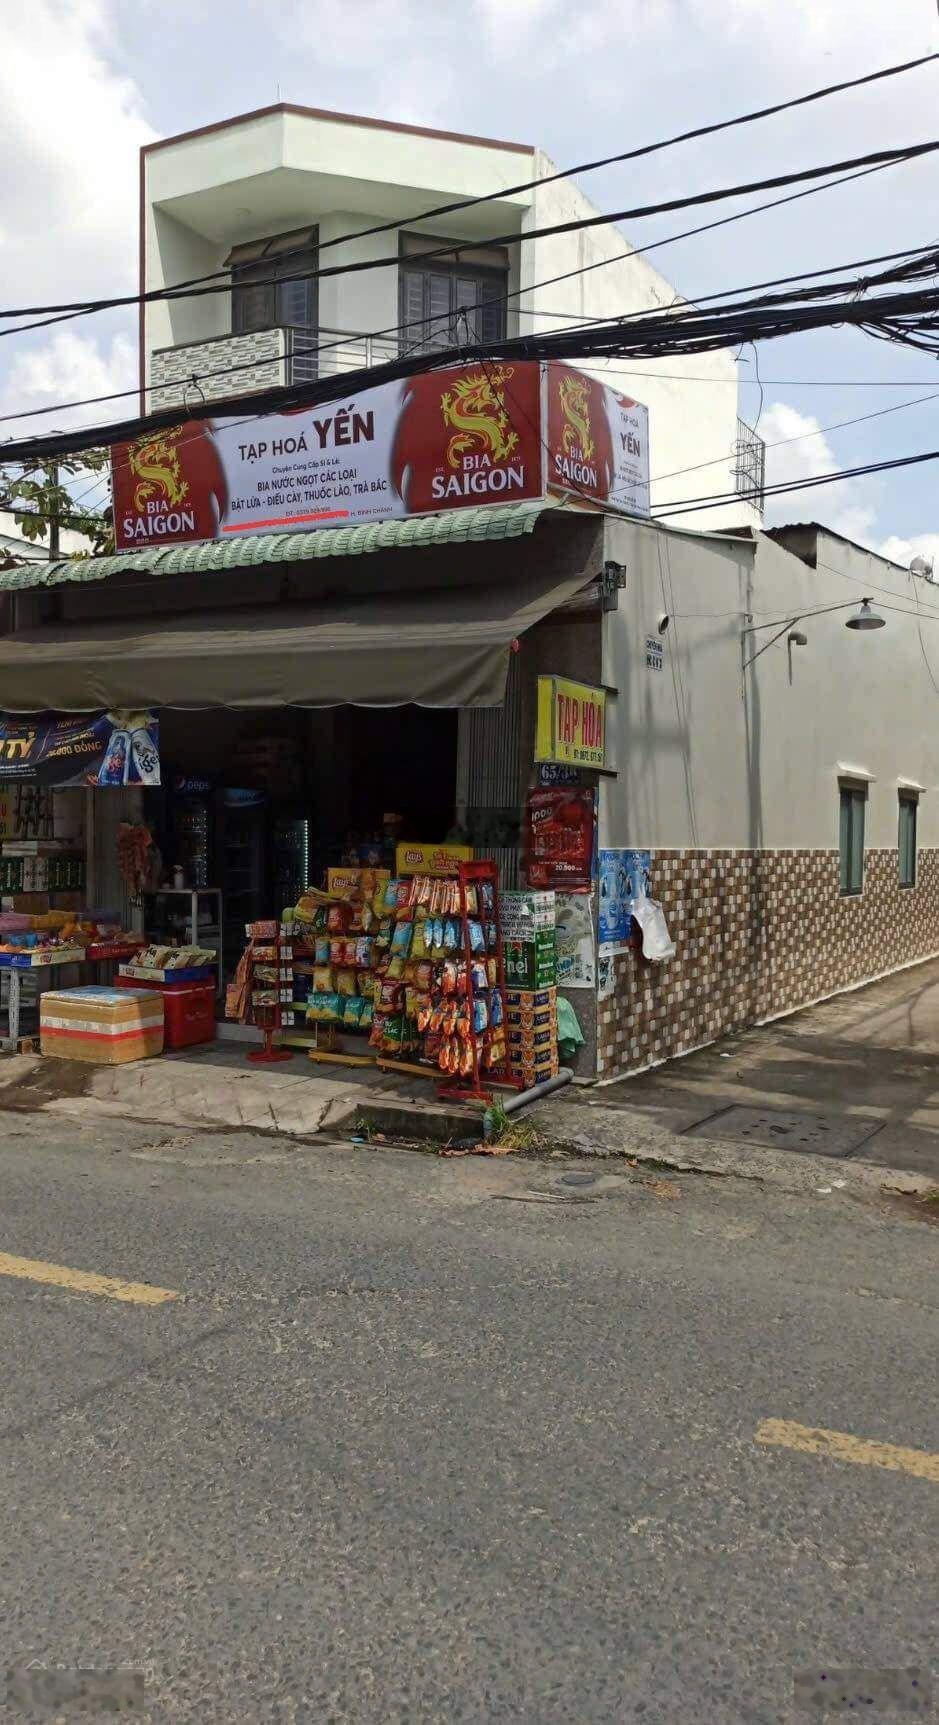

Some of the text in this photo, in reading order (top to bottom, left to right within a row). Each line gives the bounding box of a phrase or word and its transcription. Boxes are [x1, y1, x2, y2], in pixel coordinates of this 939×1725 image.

[238, 403, 375, 464] TẠP HOÁ YẾN
[620, 431, 640, 457] YẾN
[463, 454, 491, 470] BIA
[571, 446, 583, 462] BIA
[257, 481, 270, 492] BIA
[320, 470, 336, 483] CÁC
[432, 465, 524, 498] SAIGON
[555, 454, 597, 488] SAIGON
[304, 486, 332, 500] THUỐC
[147, 501, 169, 514] BIA
[123, 511, 195, 538] SAIGON
